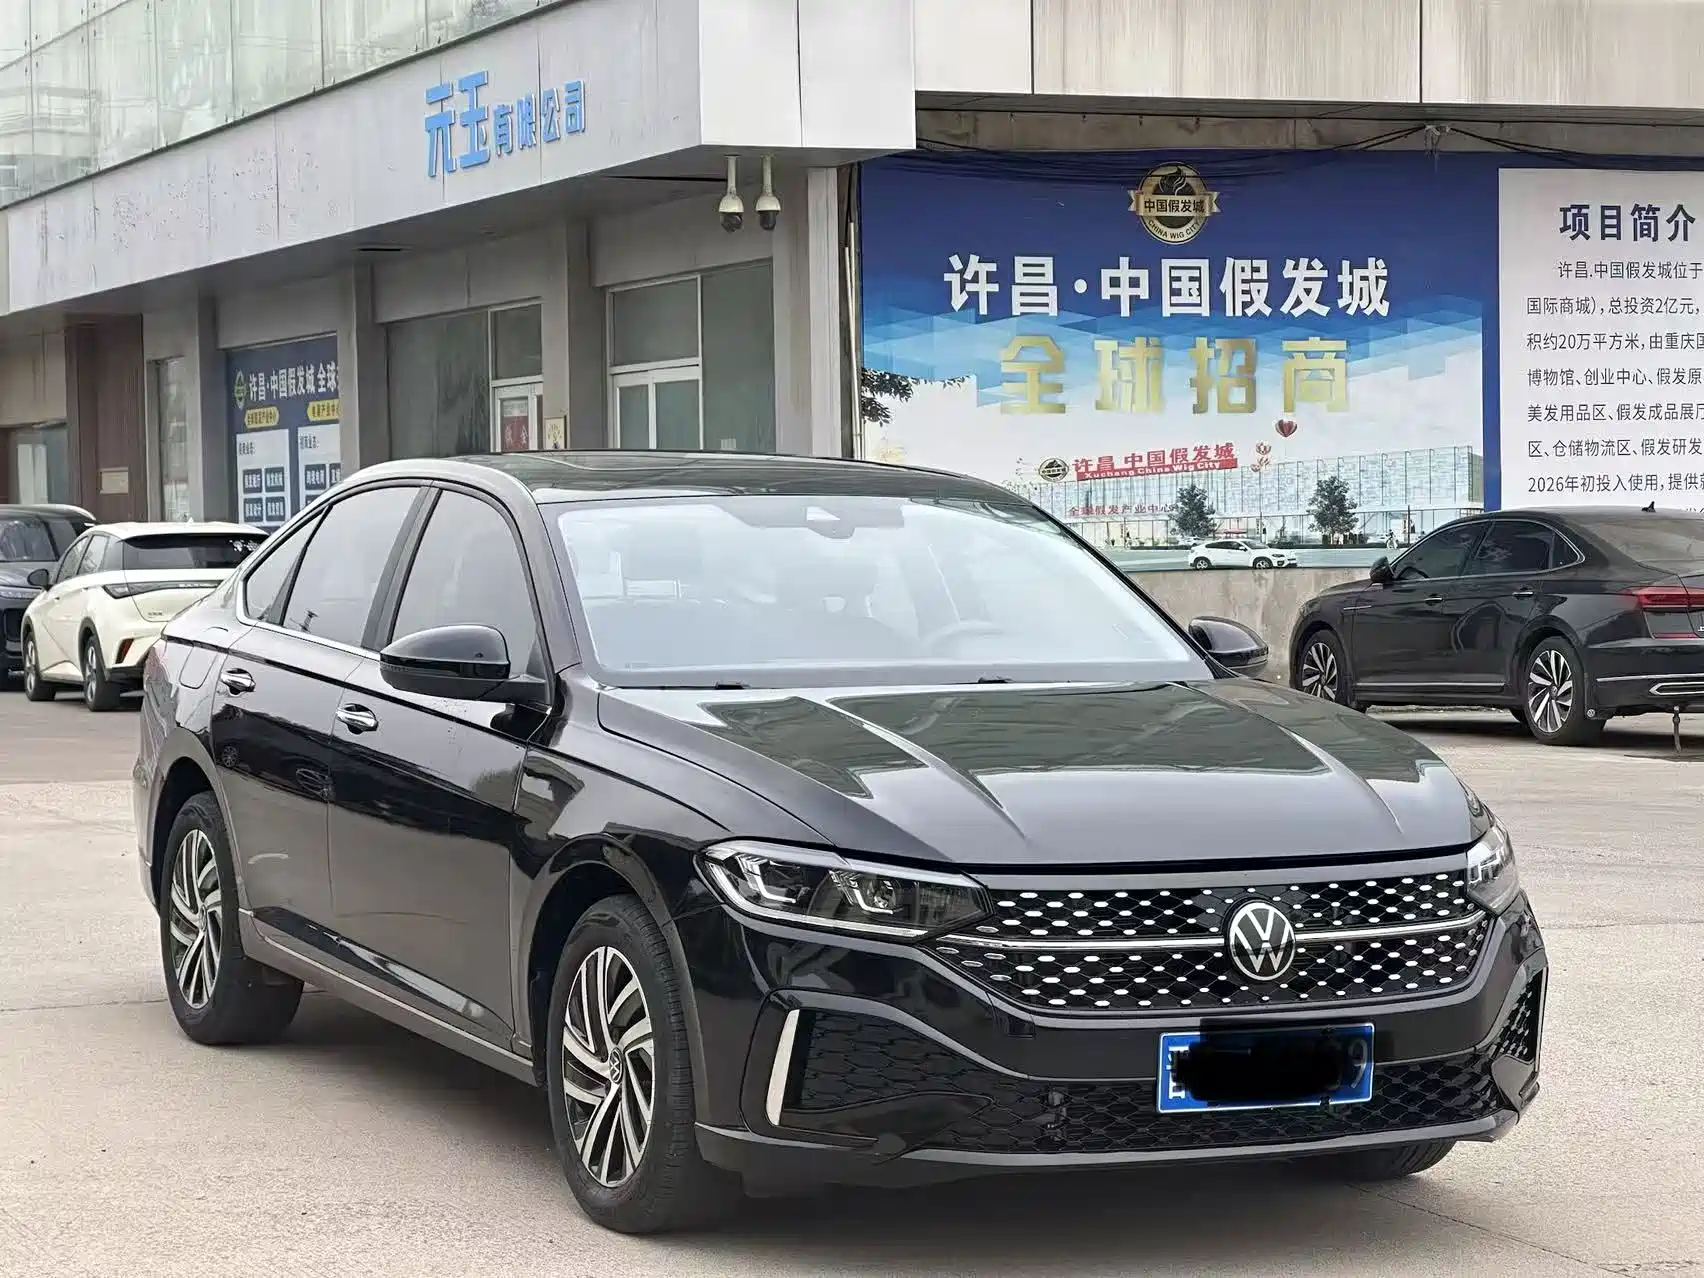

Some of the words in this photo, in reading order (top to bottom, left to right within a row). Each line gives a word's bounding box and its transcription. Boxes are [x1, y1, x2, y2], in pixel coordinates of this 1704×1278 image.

[424, 69, 585, 178] 元玉有限公司
[1144, 199, 1206, 213] 中国假发城
[1148, 220, 1168, 238] CHINA
[1169, 231, 1184, 239] WIG
[1559, 204, 1696, 242] 项目简介
[943, 254, 1390, 317] 许昌·中国假发城
[317, 361, 340, 393] 全球
[1000, 334, 1350, 414] 全球招商
[1072, 456, 1114, 472] 许昌
[1124, 443, 1235, 468] 中国假发城
[1084, 468, 1135, 479] Xuchang
[1137, 465, 1170, 475] China
[1173, 463, 1195, 473] Wig
[1196, 460, 1221, 470] City
